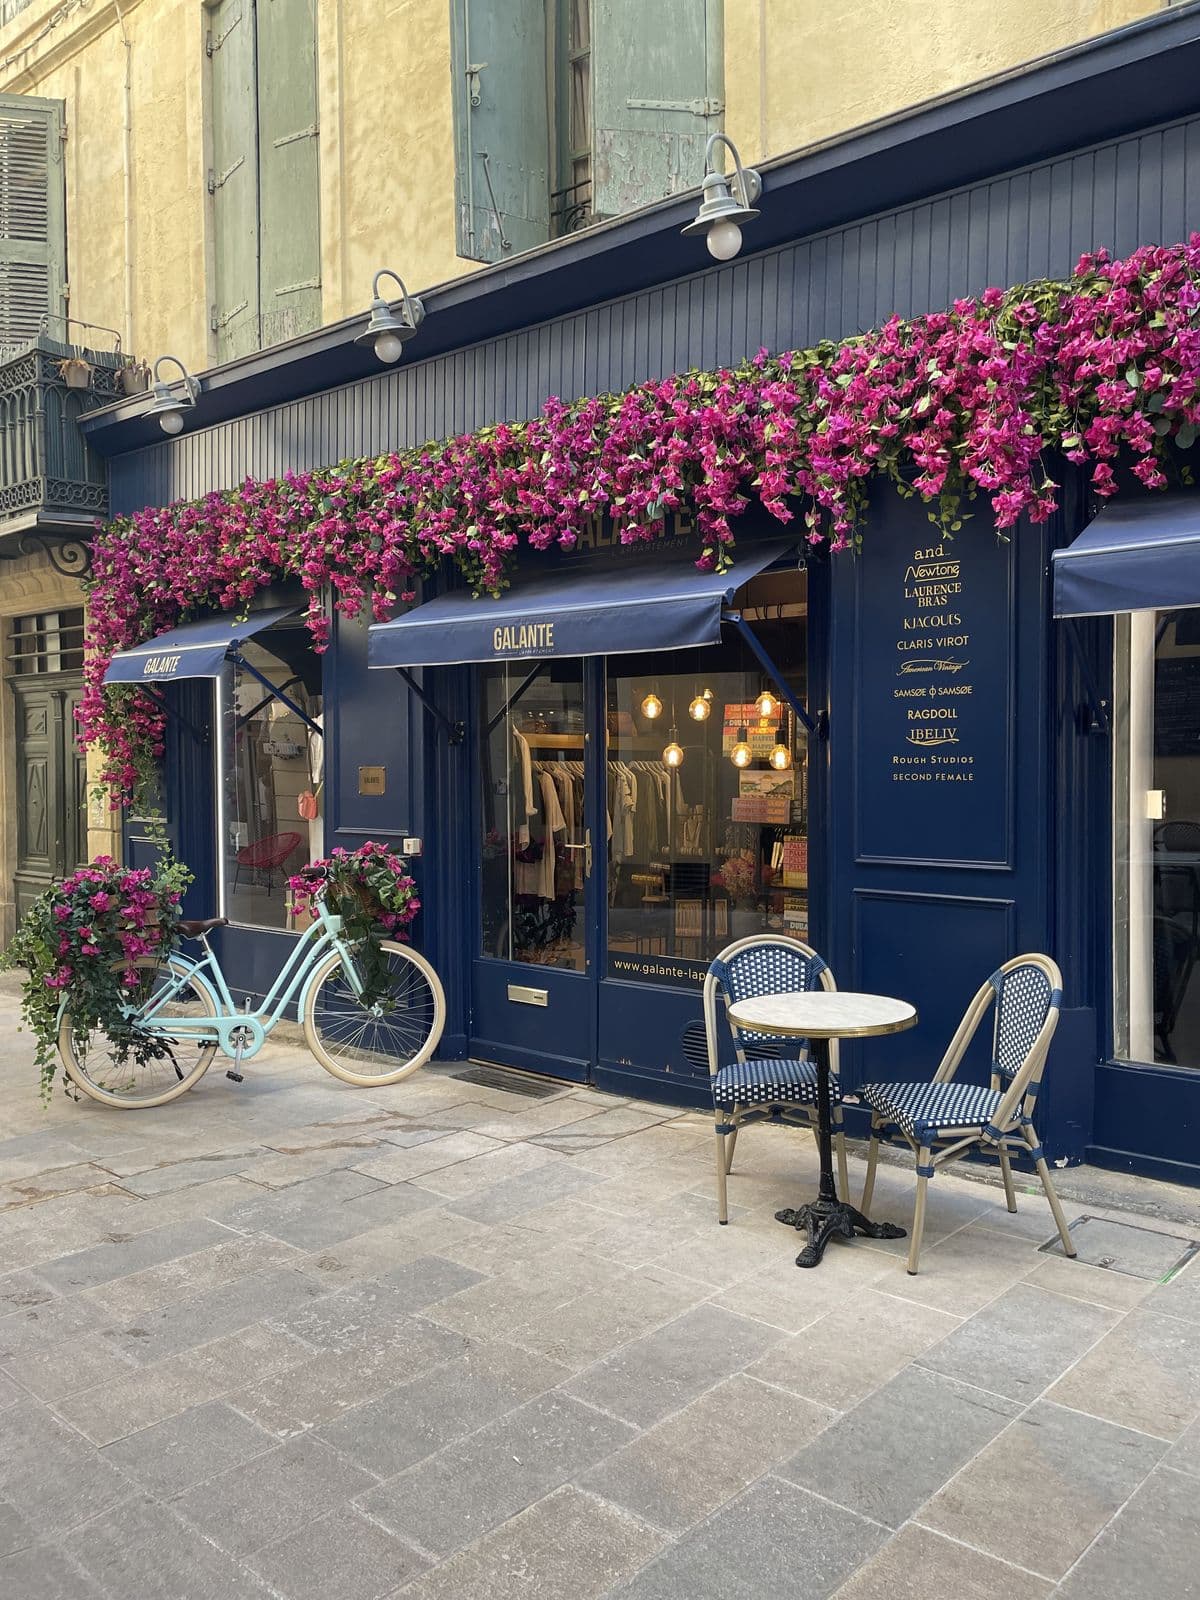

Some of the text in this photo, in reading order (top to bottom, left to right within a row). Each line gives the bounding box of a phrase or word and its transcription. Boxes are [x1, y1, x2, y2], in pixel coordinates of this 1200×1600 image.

[904, 561, 960, 582] Newtone
[904, 582, 962, 598] LAURENCE
[918, 595, 948, 608] BRAS
[493, 623, 554, 651] GALANTE
[897, 635, 969, 650] CLARIS VIROT
[143, 656, 181, 674] GALANTE
[907, 708, 958, 719] RAGDOLL
[910, 727, 958, 740] IBELIV
[892, 773, 974, 781] SECOND FEMALE
